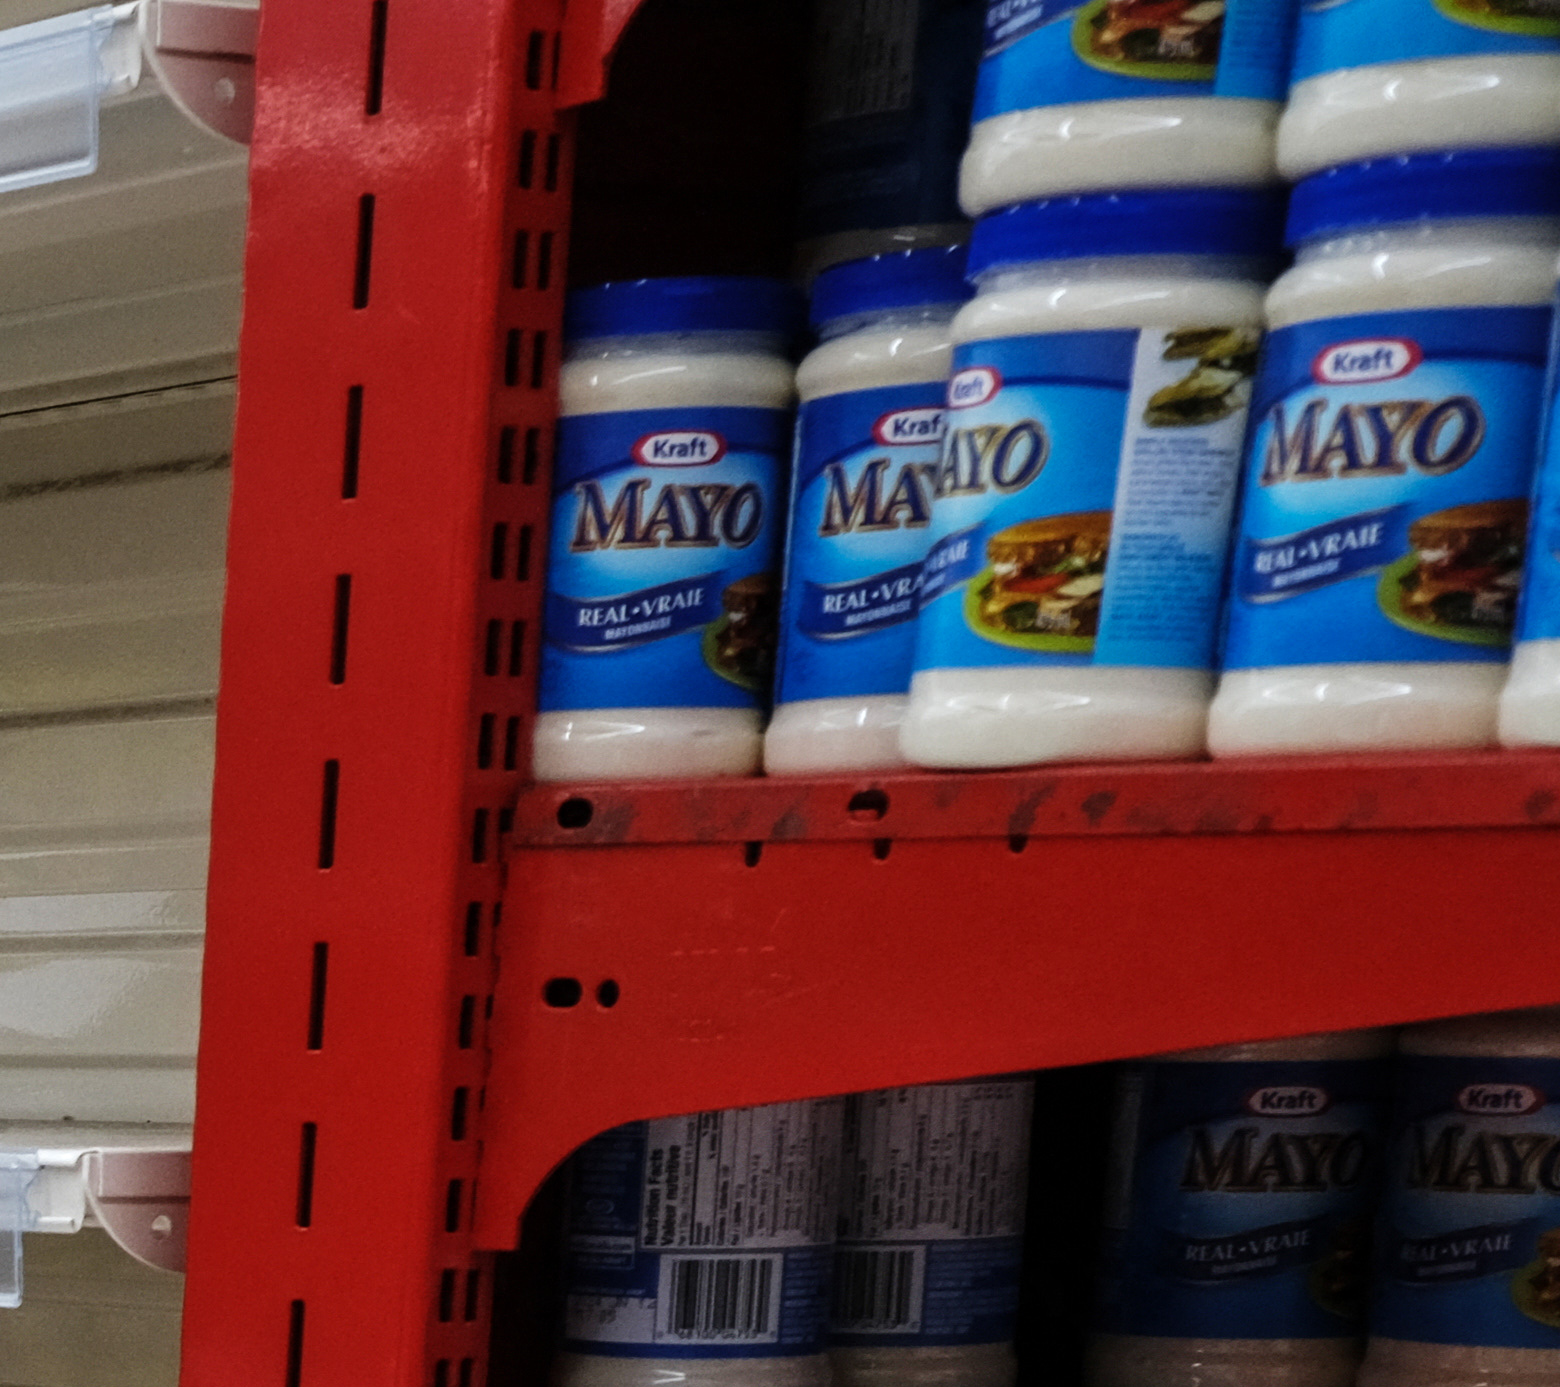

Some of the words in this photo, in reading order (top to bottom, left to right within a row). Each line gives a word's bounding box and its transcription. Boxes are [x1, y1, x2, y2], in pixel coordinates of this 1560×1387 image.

[1331, 348, 1394, 375] Kraft
[892, 415, 943, 437] Kraf
[1259, 396, 1487, 488] MAYO
[653, 436, 708, 460] Kraft
[933, 418, 1052, 499] AYO
[570, 480, 762, 552] MAYO
[818, 460, 932, 537] MA
[578, 606, 630, 628] REAL
[640, 588, 705, 616] VRAIE
[823, 588, 870, 613] REAL
[880, 575, 924, 600] VRA
[1260, 1090, 1317, 1110] Kraft
[1468, 1089, 1522, 1110] Kraft
[1179, 1126, 1368, 1191] MAYO
[1248, 1229, 1310, 1257] VRAIE
